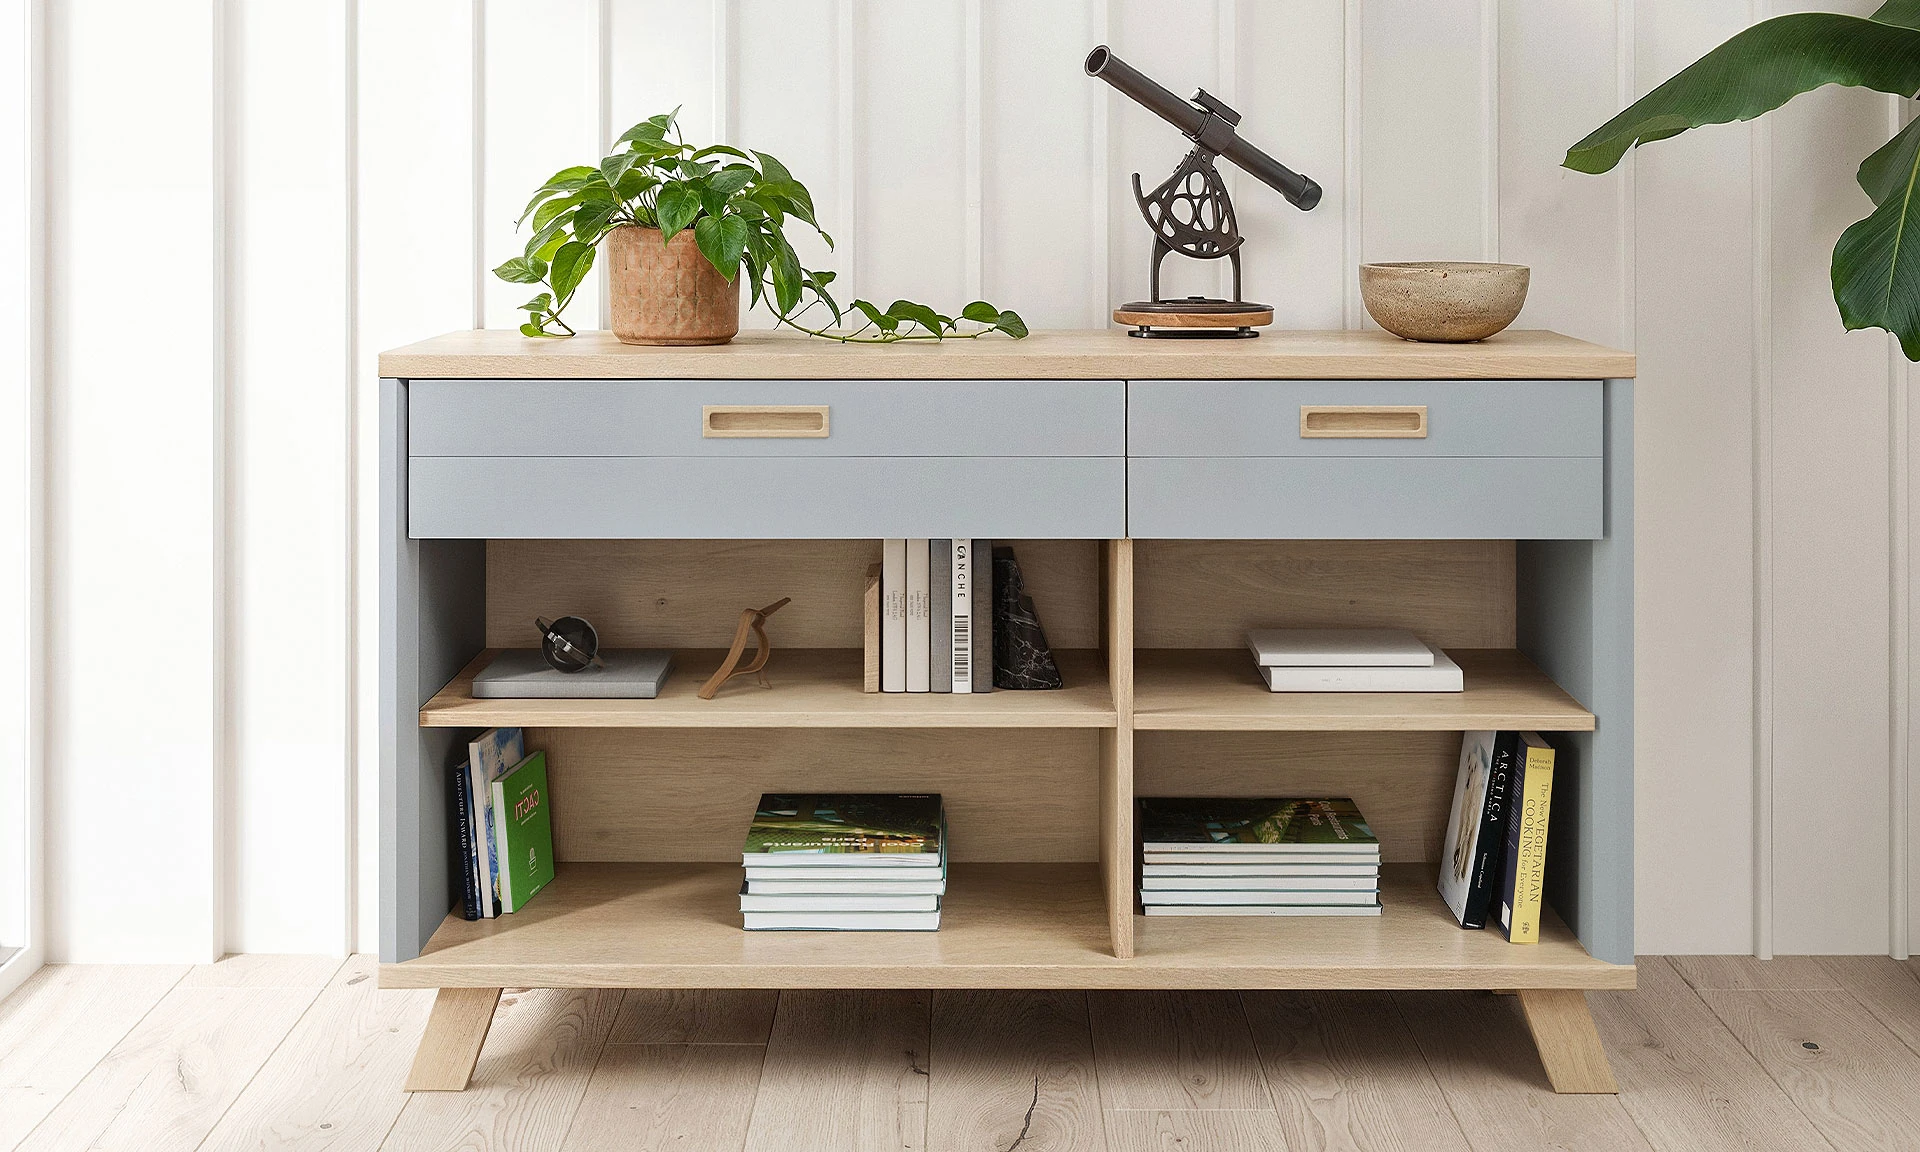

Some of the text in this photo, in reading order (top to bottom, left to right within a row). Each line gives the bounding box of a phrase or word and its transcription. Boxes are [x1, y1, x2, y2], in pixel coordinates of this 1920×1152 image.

[456, 772, 467, 849] ADVENTURE INWARD
[1490, 750, 1509, 822] ARCTICA
[1522, 798, 1536, 858] COOKING
[1529, 782, 1550, 903] The New VEGETARIAN
[1517, 872, 1527, 909] Everyone
